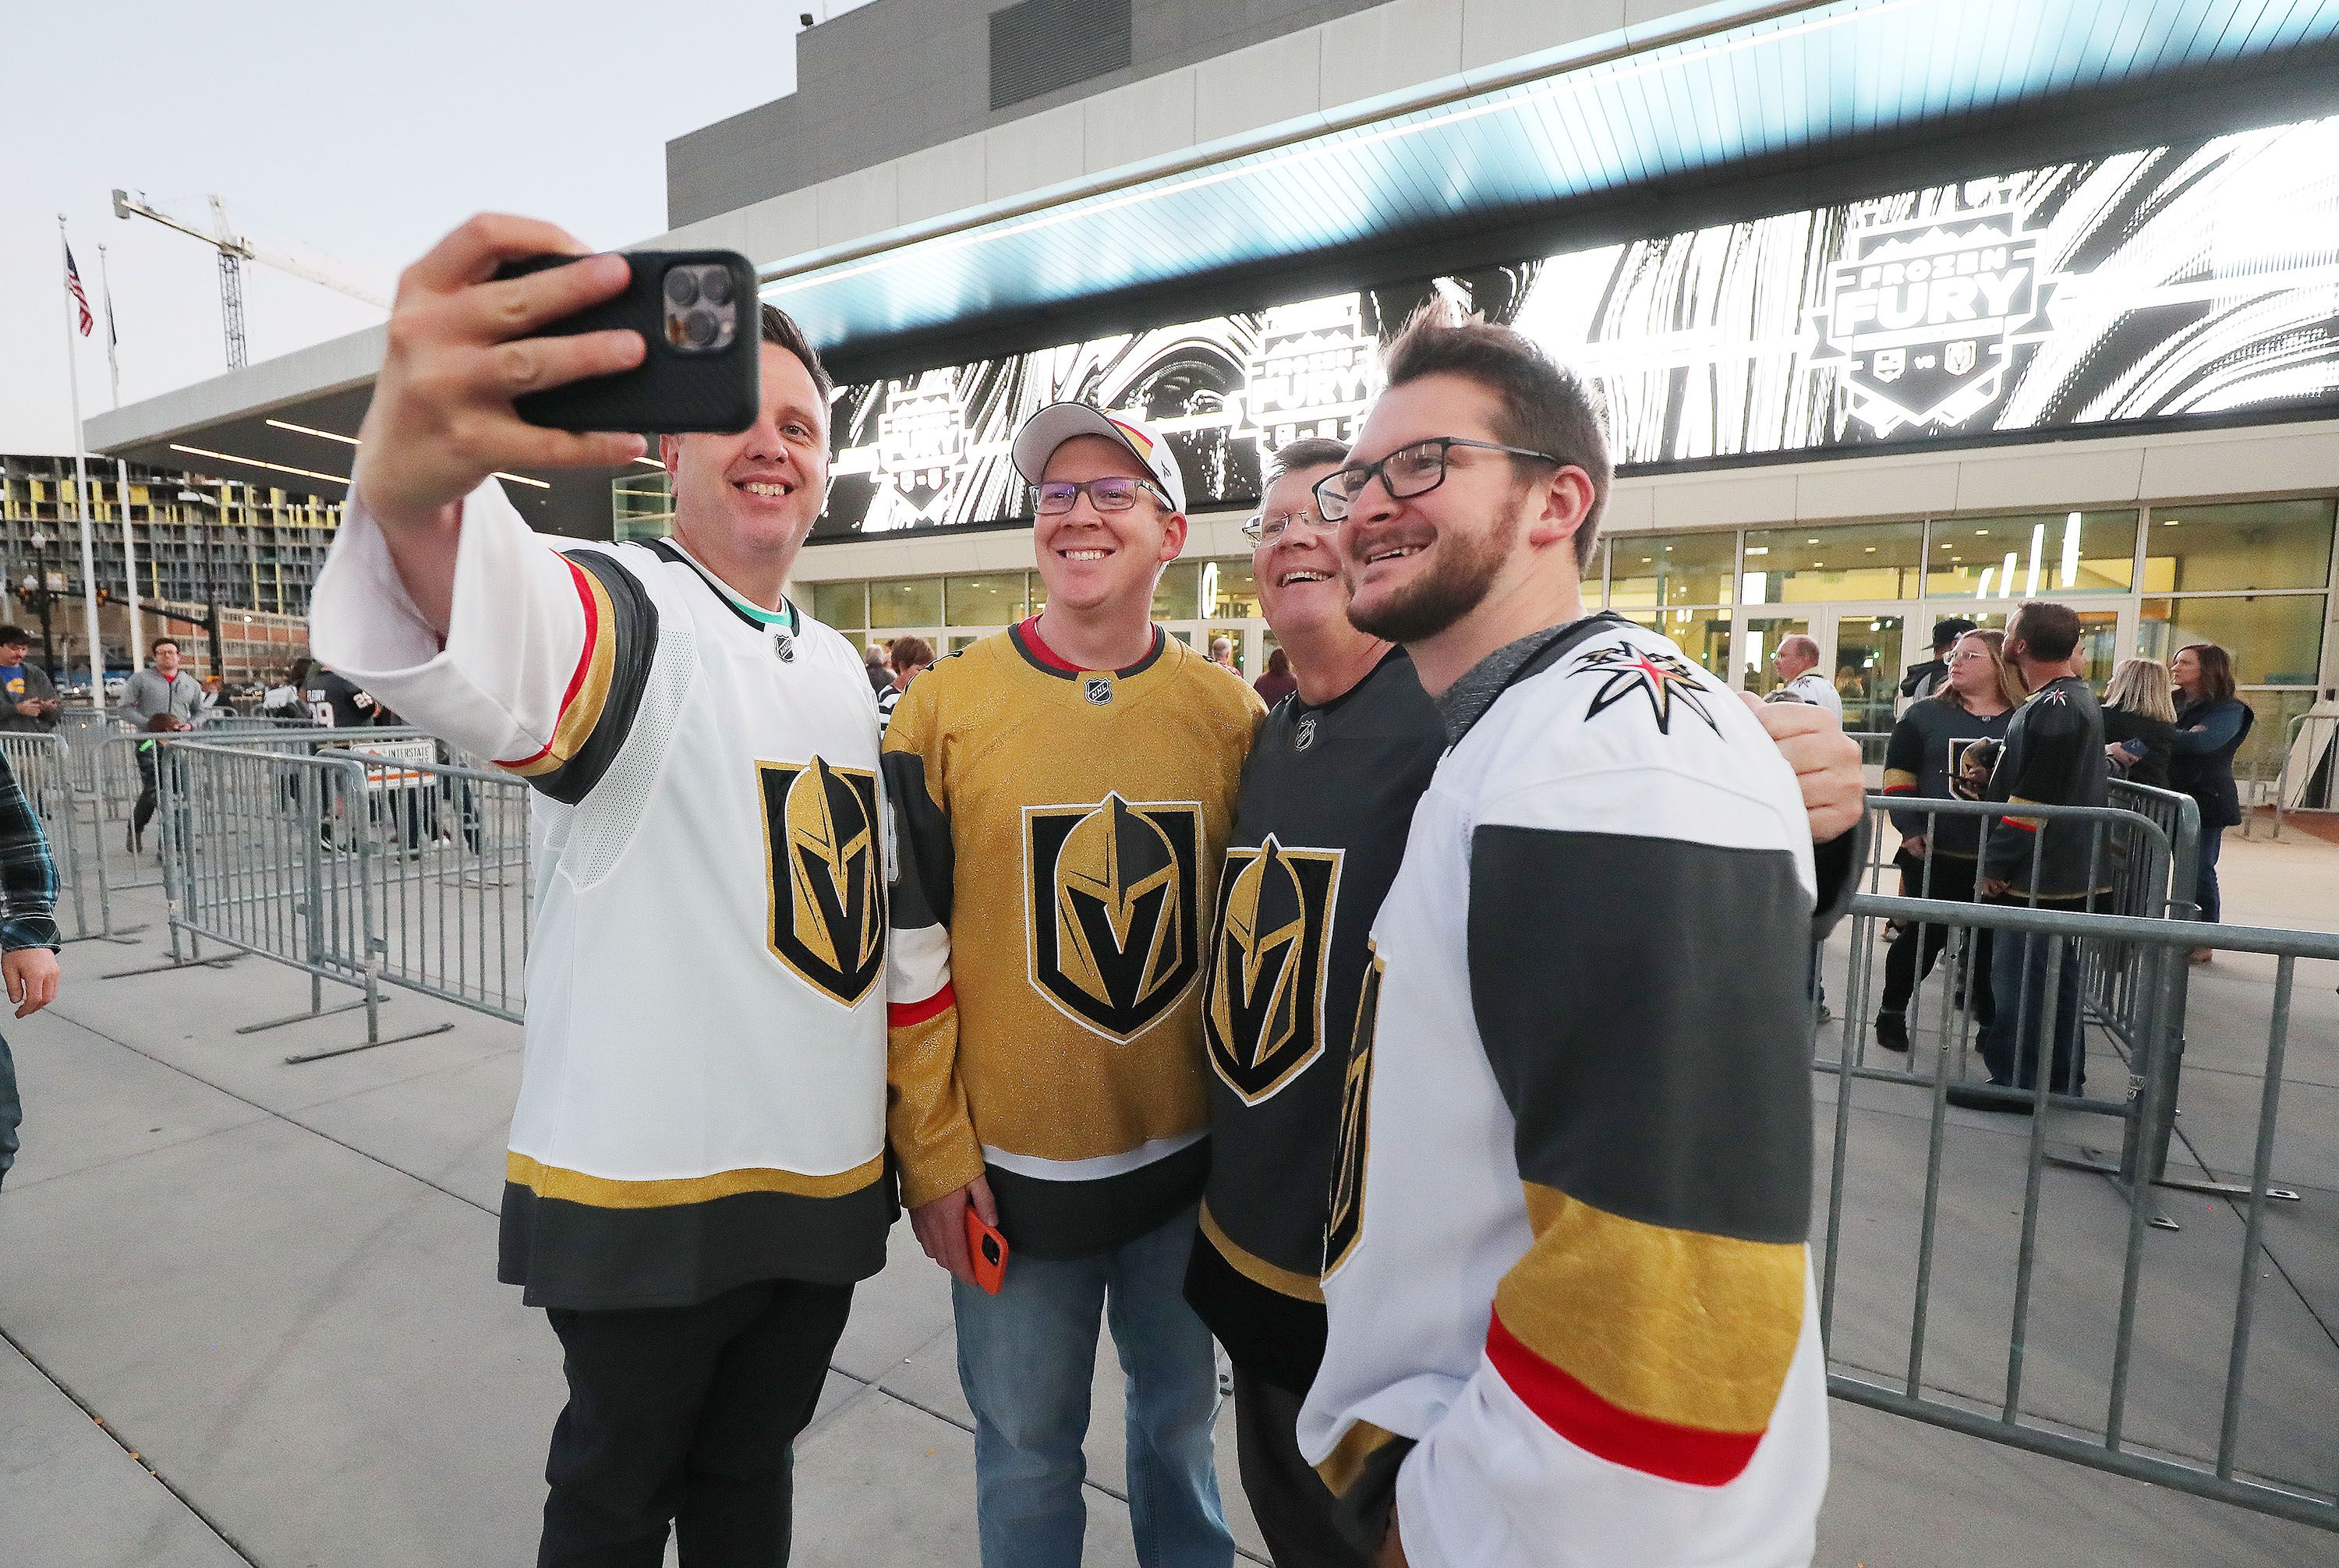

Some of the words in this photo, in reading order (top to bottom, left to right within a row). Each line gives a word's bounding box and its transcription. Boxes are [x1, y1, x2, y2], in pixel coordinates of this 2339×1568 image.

[1860, 246, 2008, 289] FROZEN
[1834, 266, 2030, 337] FURY
[1251, 363, 1367, 414] FURY
[1092, 684, 1107, 699] NHL
[388, 748, 429, 759] INTERSTATE
